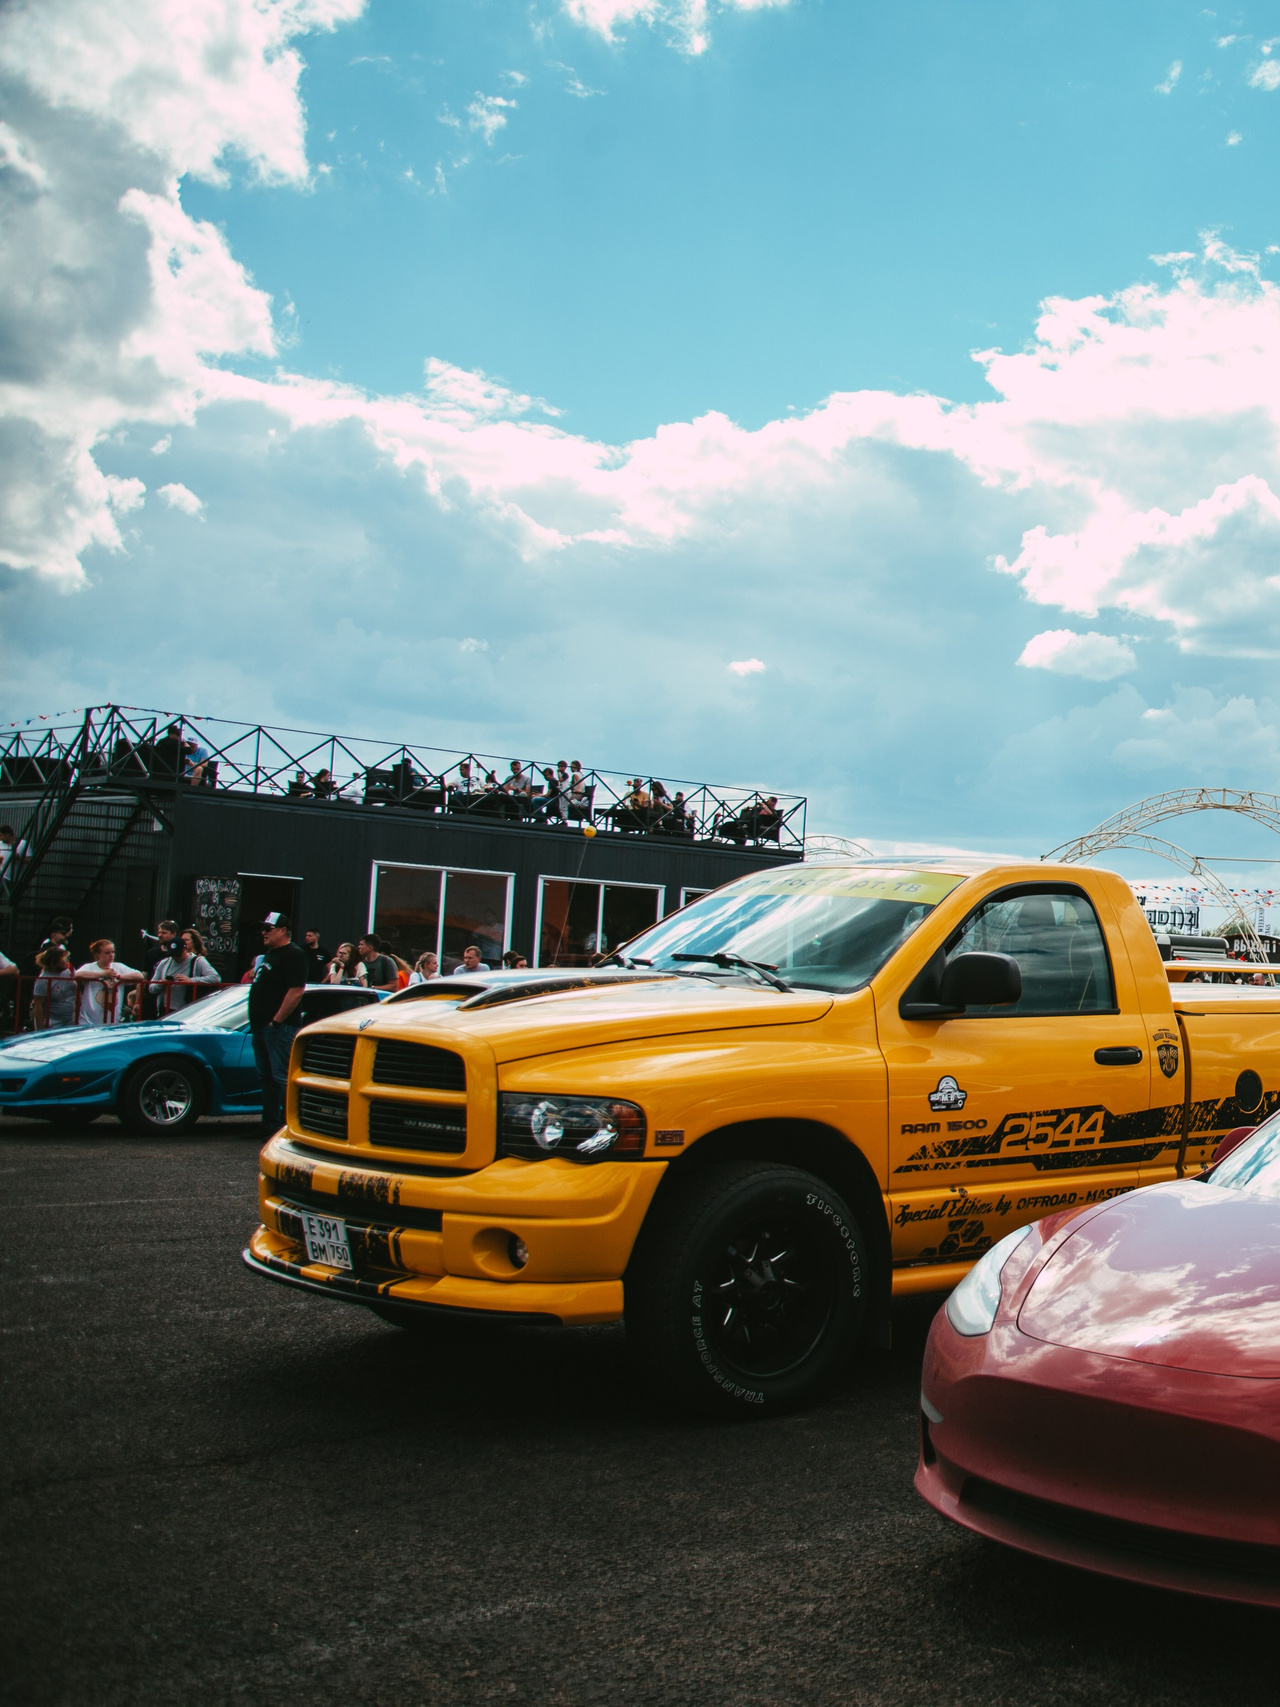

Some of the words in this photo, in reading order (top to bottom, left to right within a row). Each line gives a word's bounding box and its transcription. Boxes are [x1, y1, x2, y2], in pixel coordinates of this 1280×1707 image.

[200, 904, 232, 920] КОФЕ
[901, 1122, 941, 1135] RAM
[946, 1118, 988, 1132] 1500
[1000, 1111, 1105, 1151] 2544
[894, 1201, 946, 1227] Special
[947, 1196, 995, 1217] Edition
[995, 1194, 1013, 1216] by
[1016, 1192, 1077, 1210] OFFROAD
[330, 1244, 349, 1262] 750
[806, 1193, 861, 1298] Firestone
